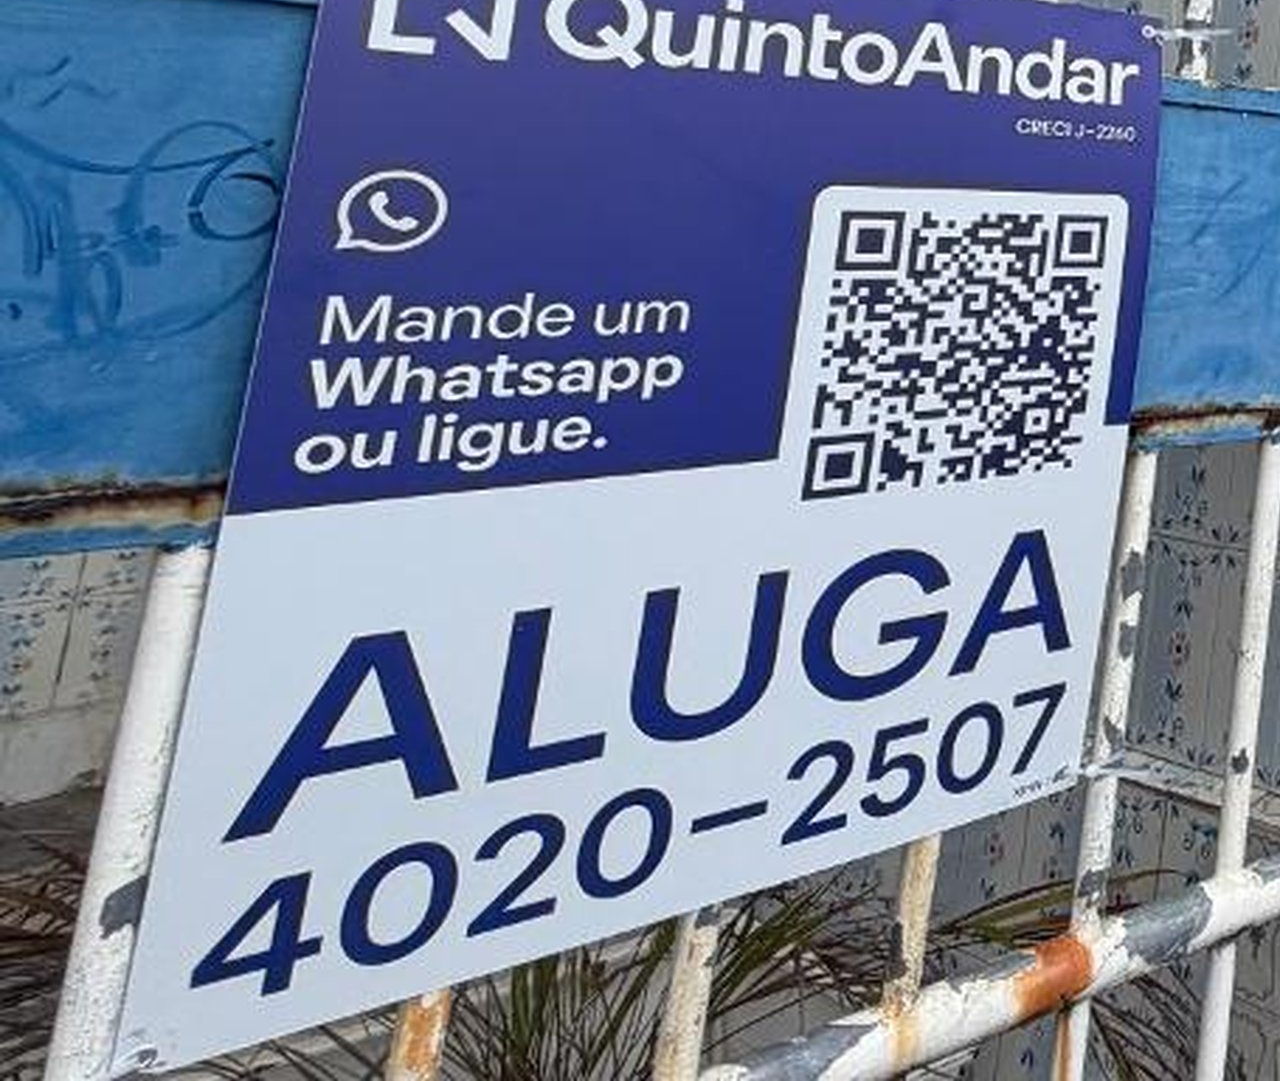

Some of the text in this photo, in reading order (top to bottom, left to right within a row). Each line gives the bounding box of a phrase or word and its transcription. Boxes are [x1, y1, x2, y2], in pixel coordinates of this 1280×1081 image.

[1015, 118, 1072, 137] CRECI
[319, 292, 690, 345] Mande um
[310, 354, 684, 409] Whatsapp
[294, 412, 607, 473] ou ligue.
[221, 529, 1071, 844] ALUGA
[189, 682, 1067, 997] 4020-2507
